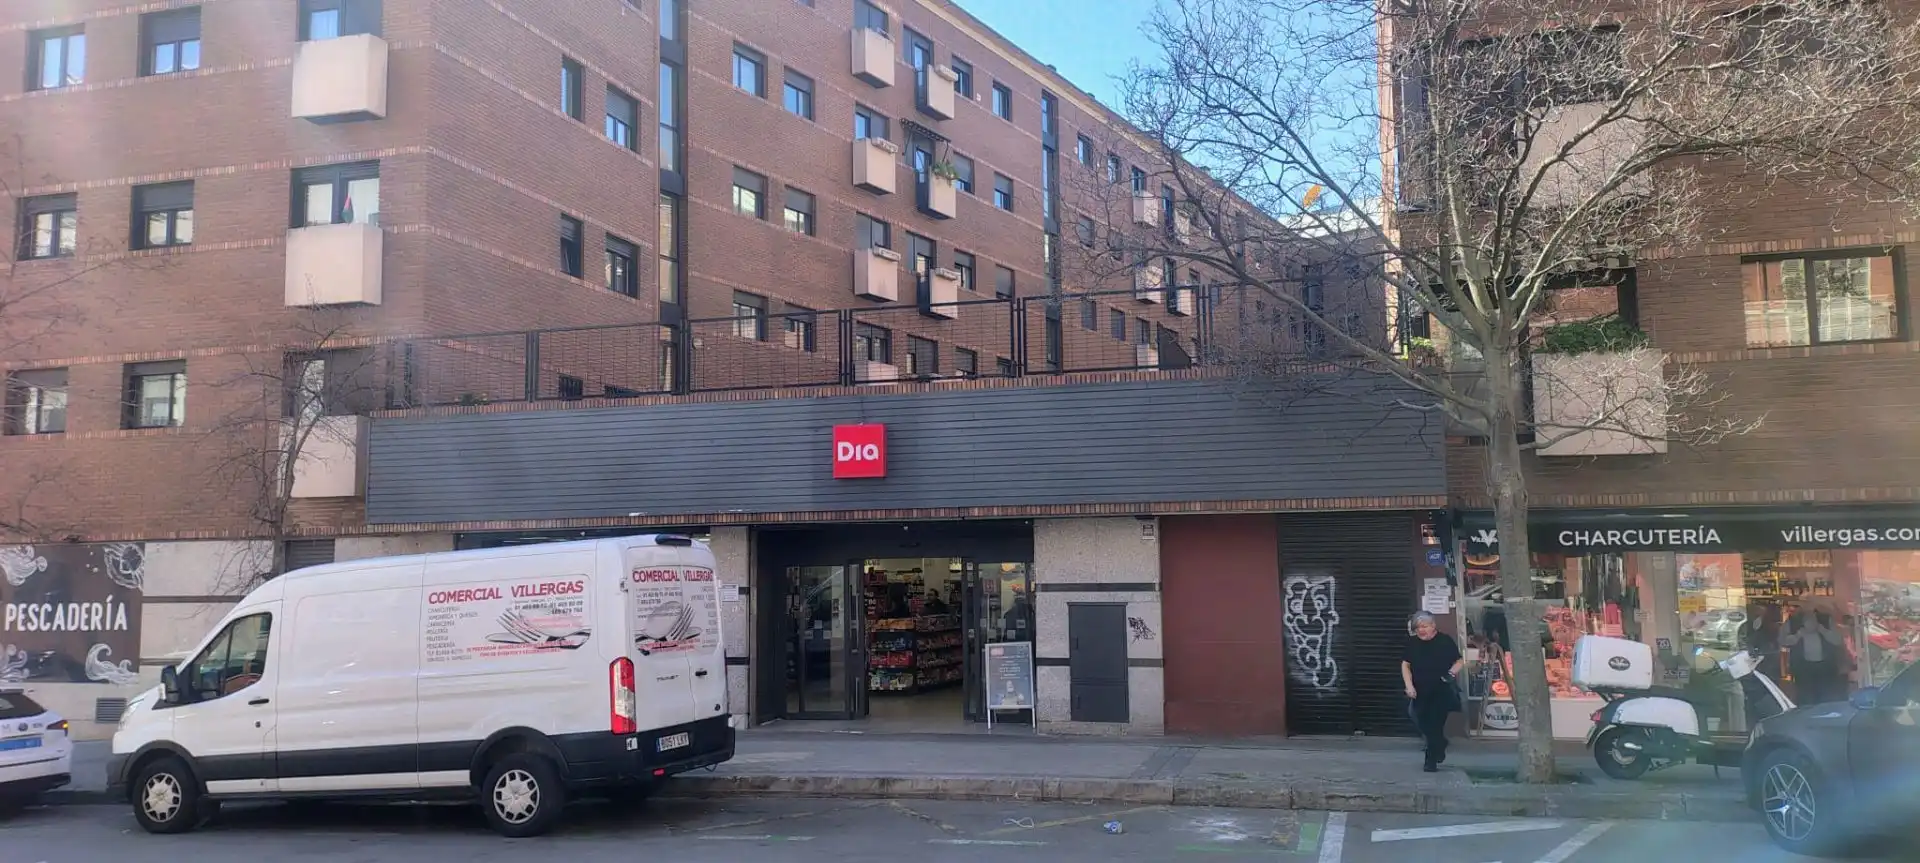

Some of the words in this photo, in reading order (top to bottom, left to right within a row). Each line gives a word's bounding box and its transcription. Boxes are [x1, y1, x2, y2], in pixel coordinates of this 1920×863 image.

[1558, 525, 1722, 546] CHARCUTERÍA
[632, 569, 680, 583] COMERCIAL
[683, 570, 714, 582] VILLERGAS
[428, 587, 503, 604] COMERCIAL
[511, 580, 584, 598] VILLERGAS
[4, 594, 128, 632] PESCADERÍA
